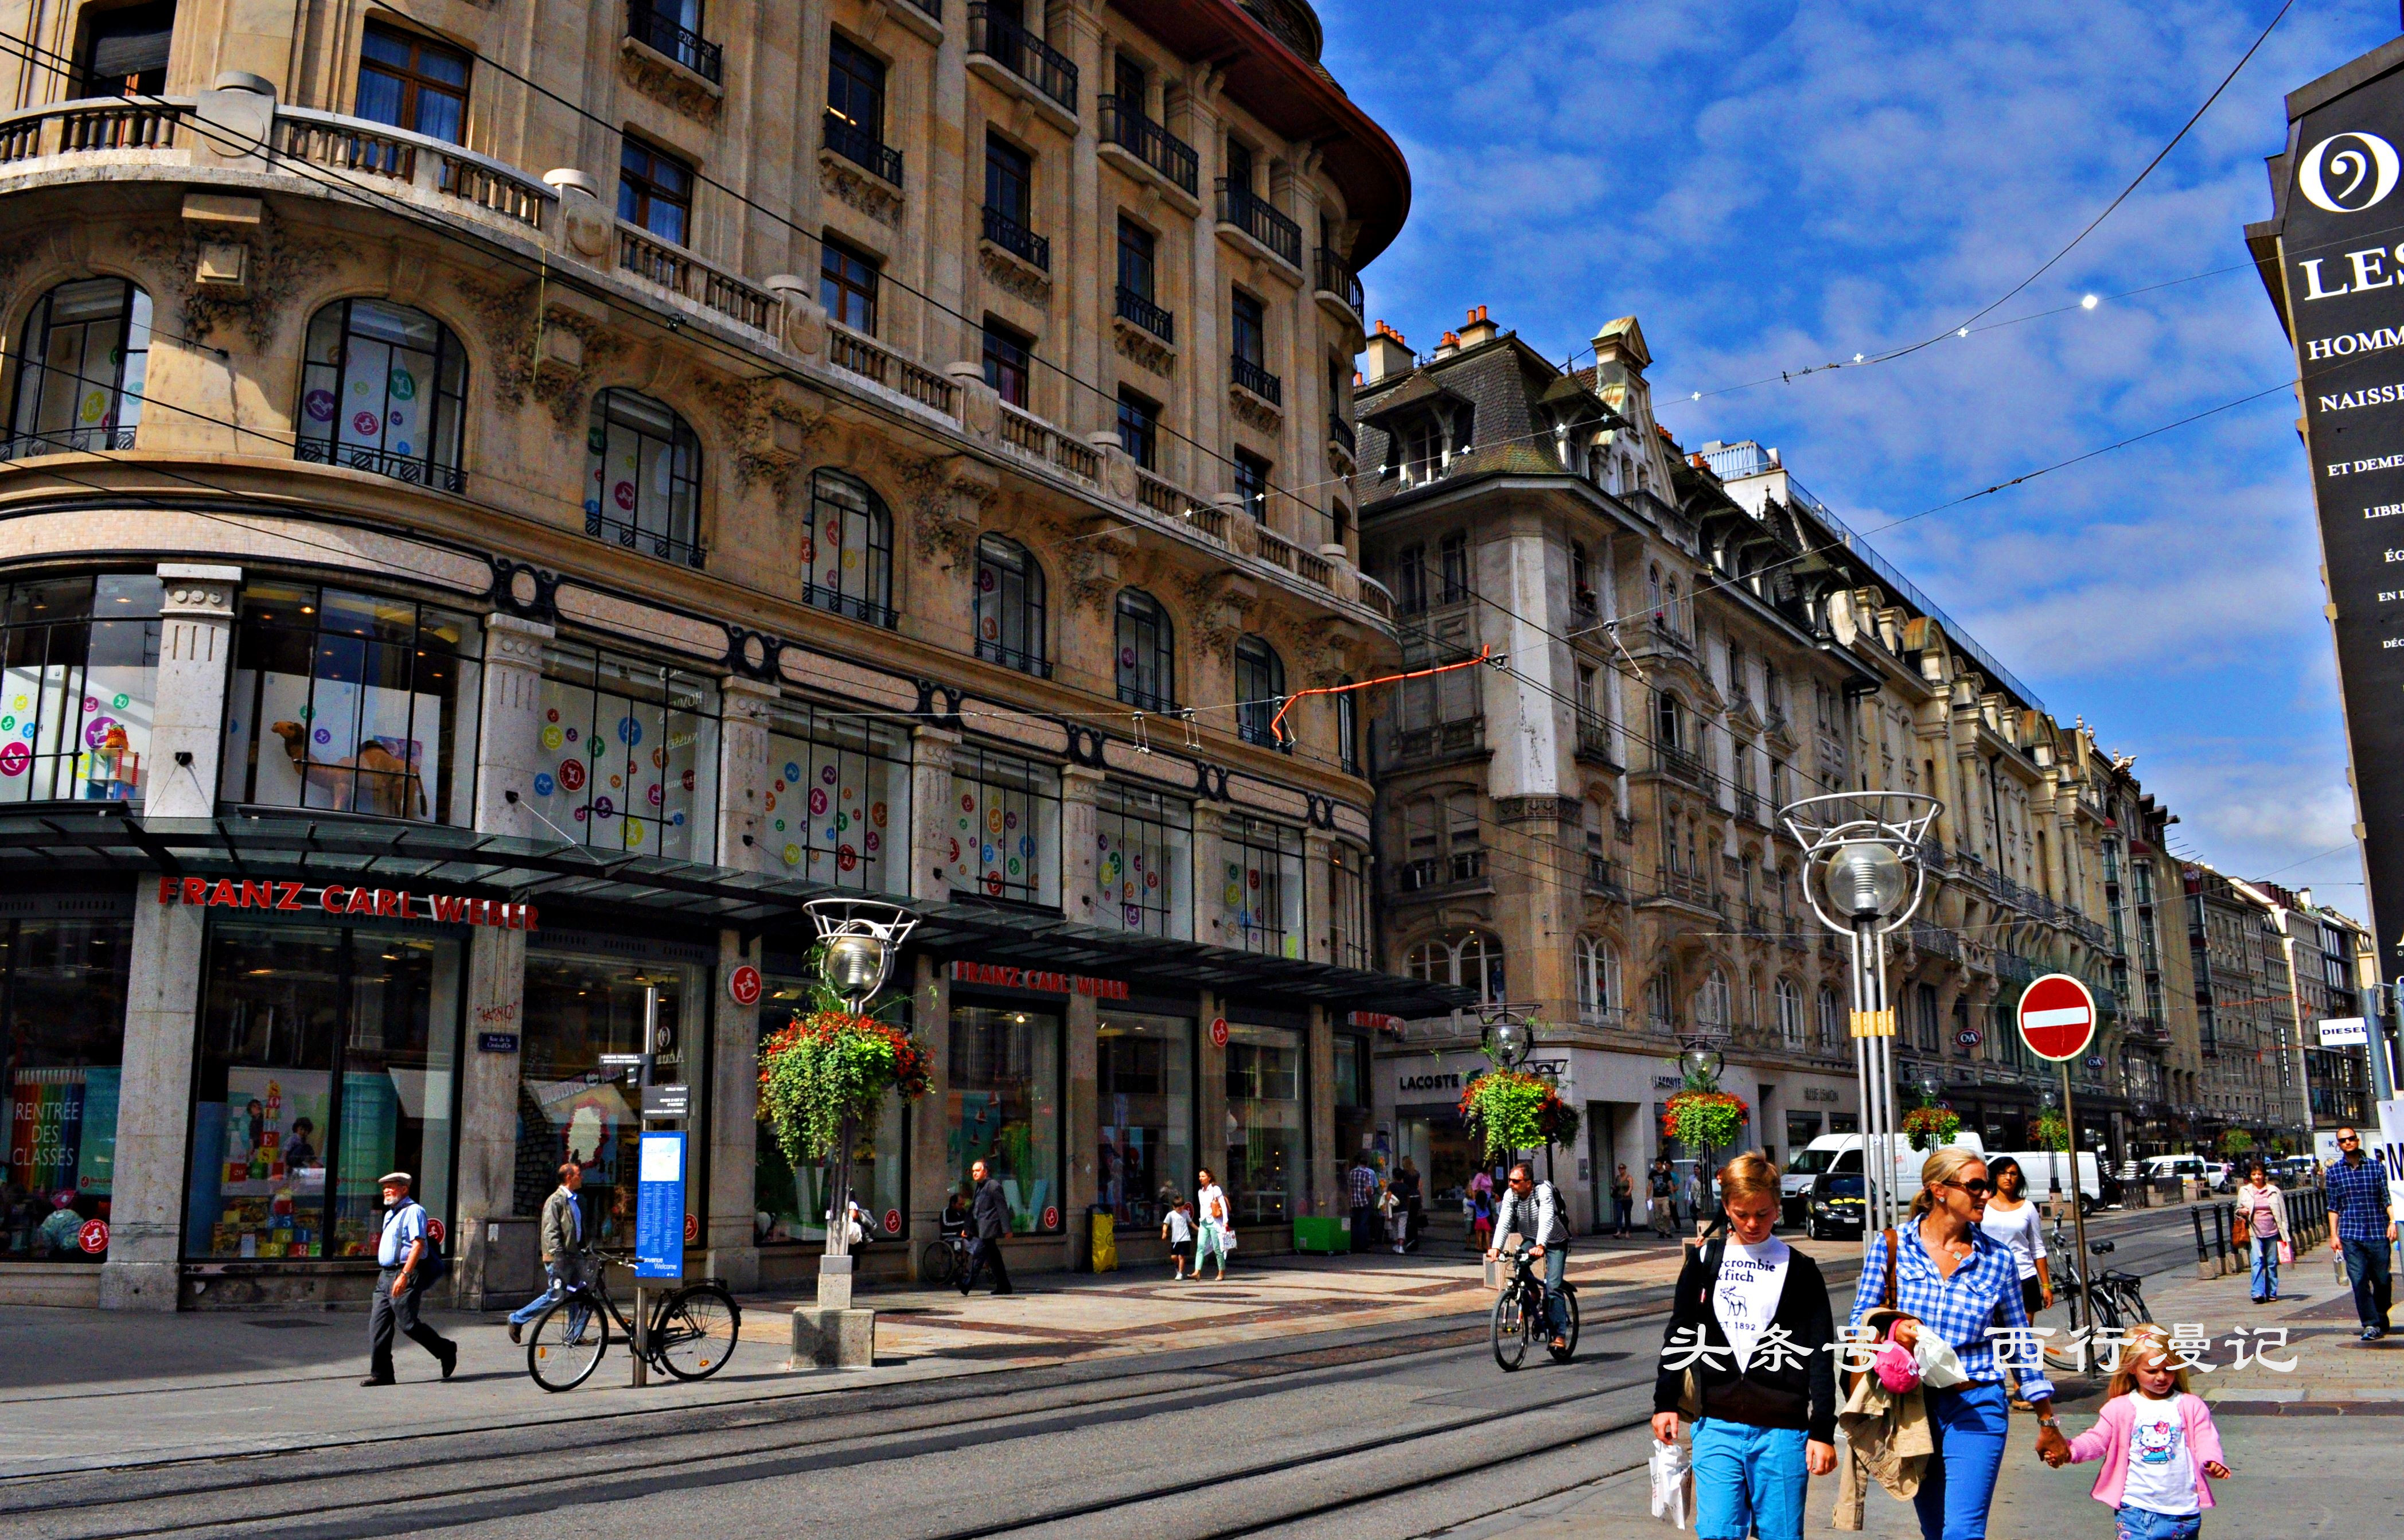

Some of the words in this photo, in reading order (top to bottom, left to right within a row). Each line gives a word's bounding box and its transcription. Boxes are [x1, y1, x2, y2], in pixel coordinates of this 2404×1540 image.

[2327, 462, 2350, 477] ET
[2364, 503, 2404, 518] LIBR
[2378, 591, 2396, 602] EN
[158, 877, 304, 910] FRANZ
[321, 884, 418, 919] CARL
[428, 894, 539, 931] WEBER
[952, 960, 1020, 988] FRANZ
[1023, 969, 1071, 993] CARL
[1073, 975, 1129, 1000] WEBER
[2322, 1027, 2366, 1035] DIESEL
[1400, 1074, 1459, 1090] LACOSTE
[15, 1098, 79, 1120] RENTRÉE
[32, 1125, 59, 1143] DES
[13, 1148, 74, 1166] CLASSES
[1721, 1258, 1776, 1272] crombie
[1725, 1269, 1754, 1282] fitch
[1735, 1321, 1756, 1331] 1892
